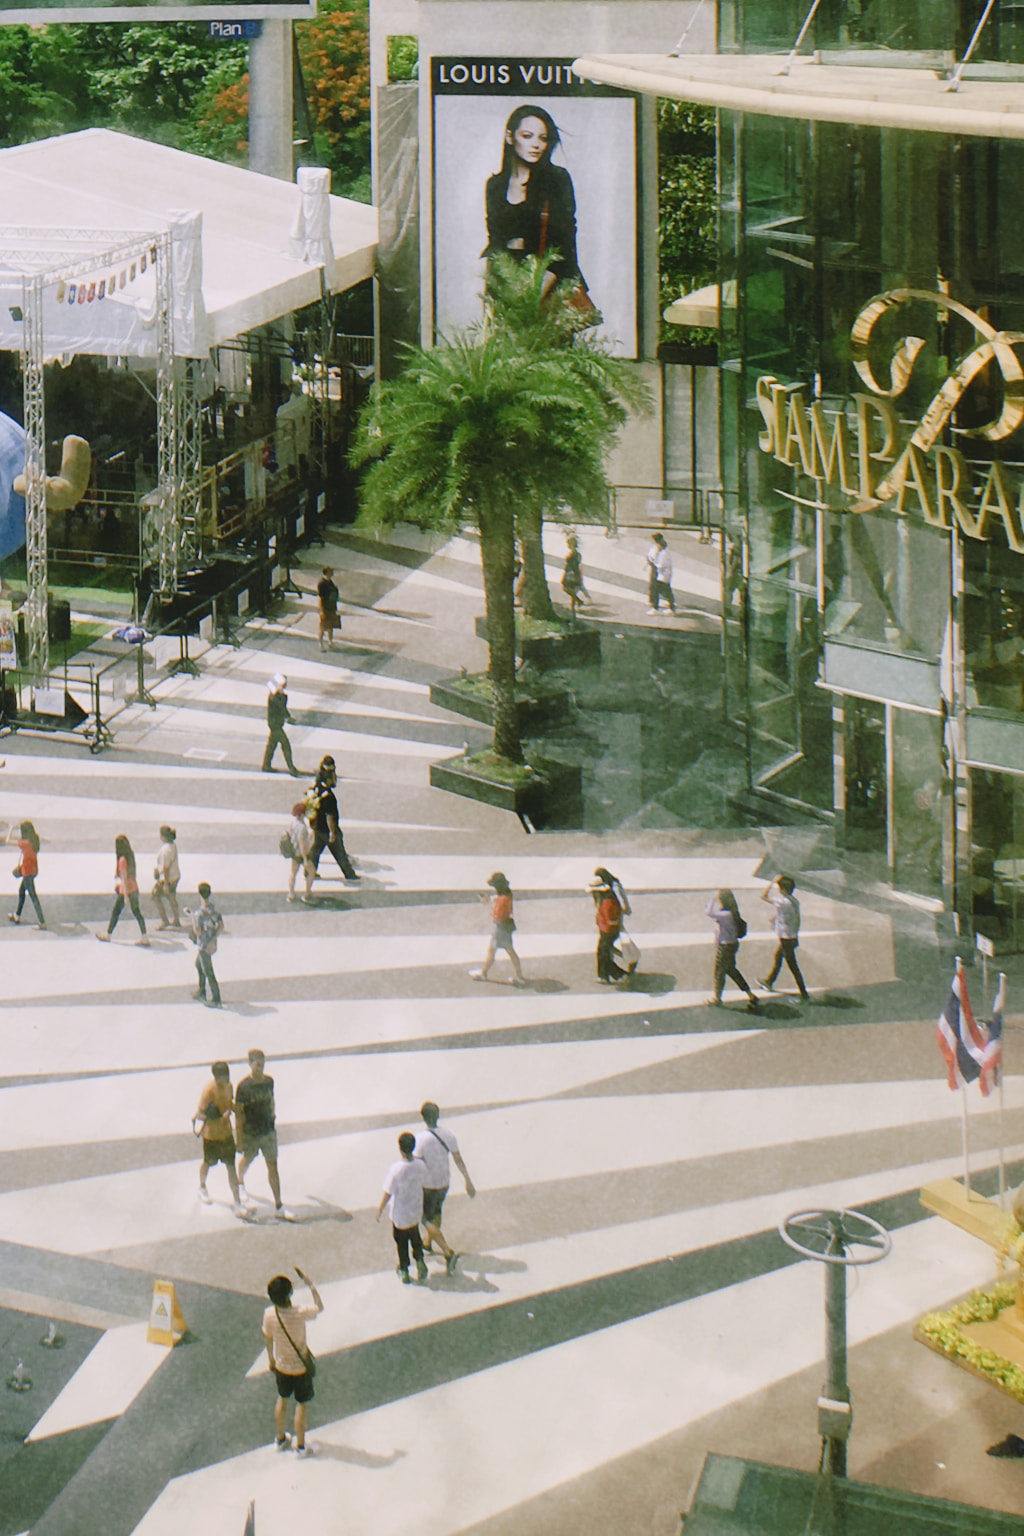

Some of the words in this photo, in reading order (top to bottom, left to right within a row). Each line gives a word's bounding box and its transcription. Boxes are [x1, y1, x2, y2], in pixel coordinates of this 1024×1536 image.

[210, 21, 242, 36] Plan
[439, 64, 511, 84] LOUIS
[519, 65, 604, 85] VUIT
[756, 375, 860, 496] SIAM
[850, 392, 1024, 554] PARA
